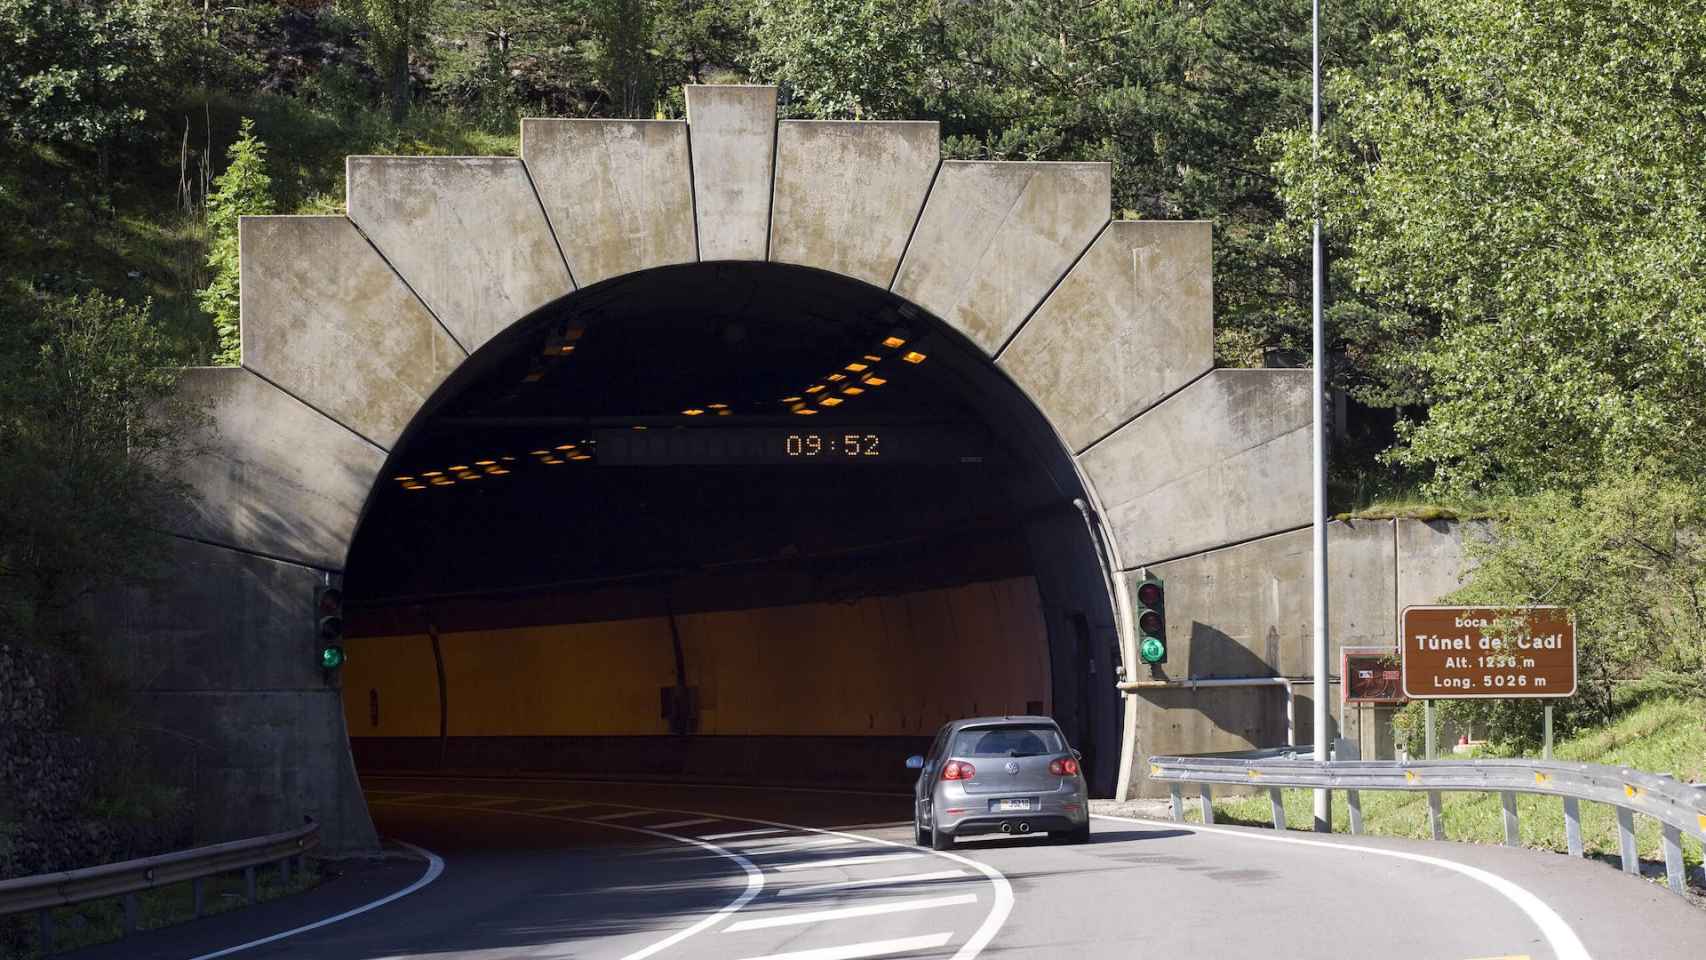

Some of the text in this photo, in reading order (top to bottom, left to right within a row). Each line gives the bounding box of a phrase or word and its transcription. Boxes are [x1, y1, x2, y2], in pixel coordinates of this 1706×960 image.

[1455, 617, 1488, 628] boca
[1415, 635, 1472, 650] Túnel
[1517, 634, 1563, 650] Cadí
[1445, 657, 1472, 668] Alt.
[1523, 659, 1535, 668] m
[1434, 675, 1547, 689] Long. 5026 m
